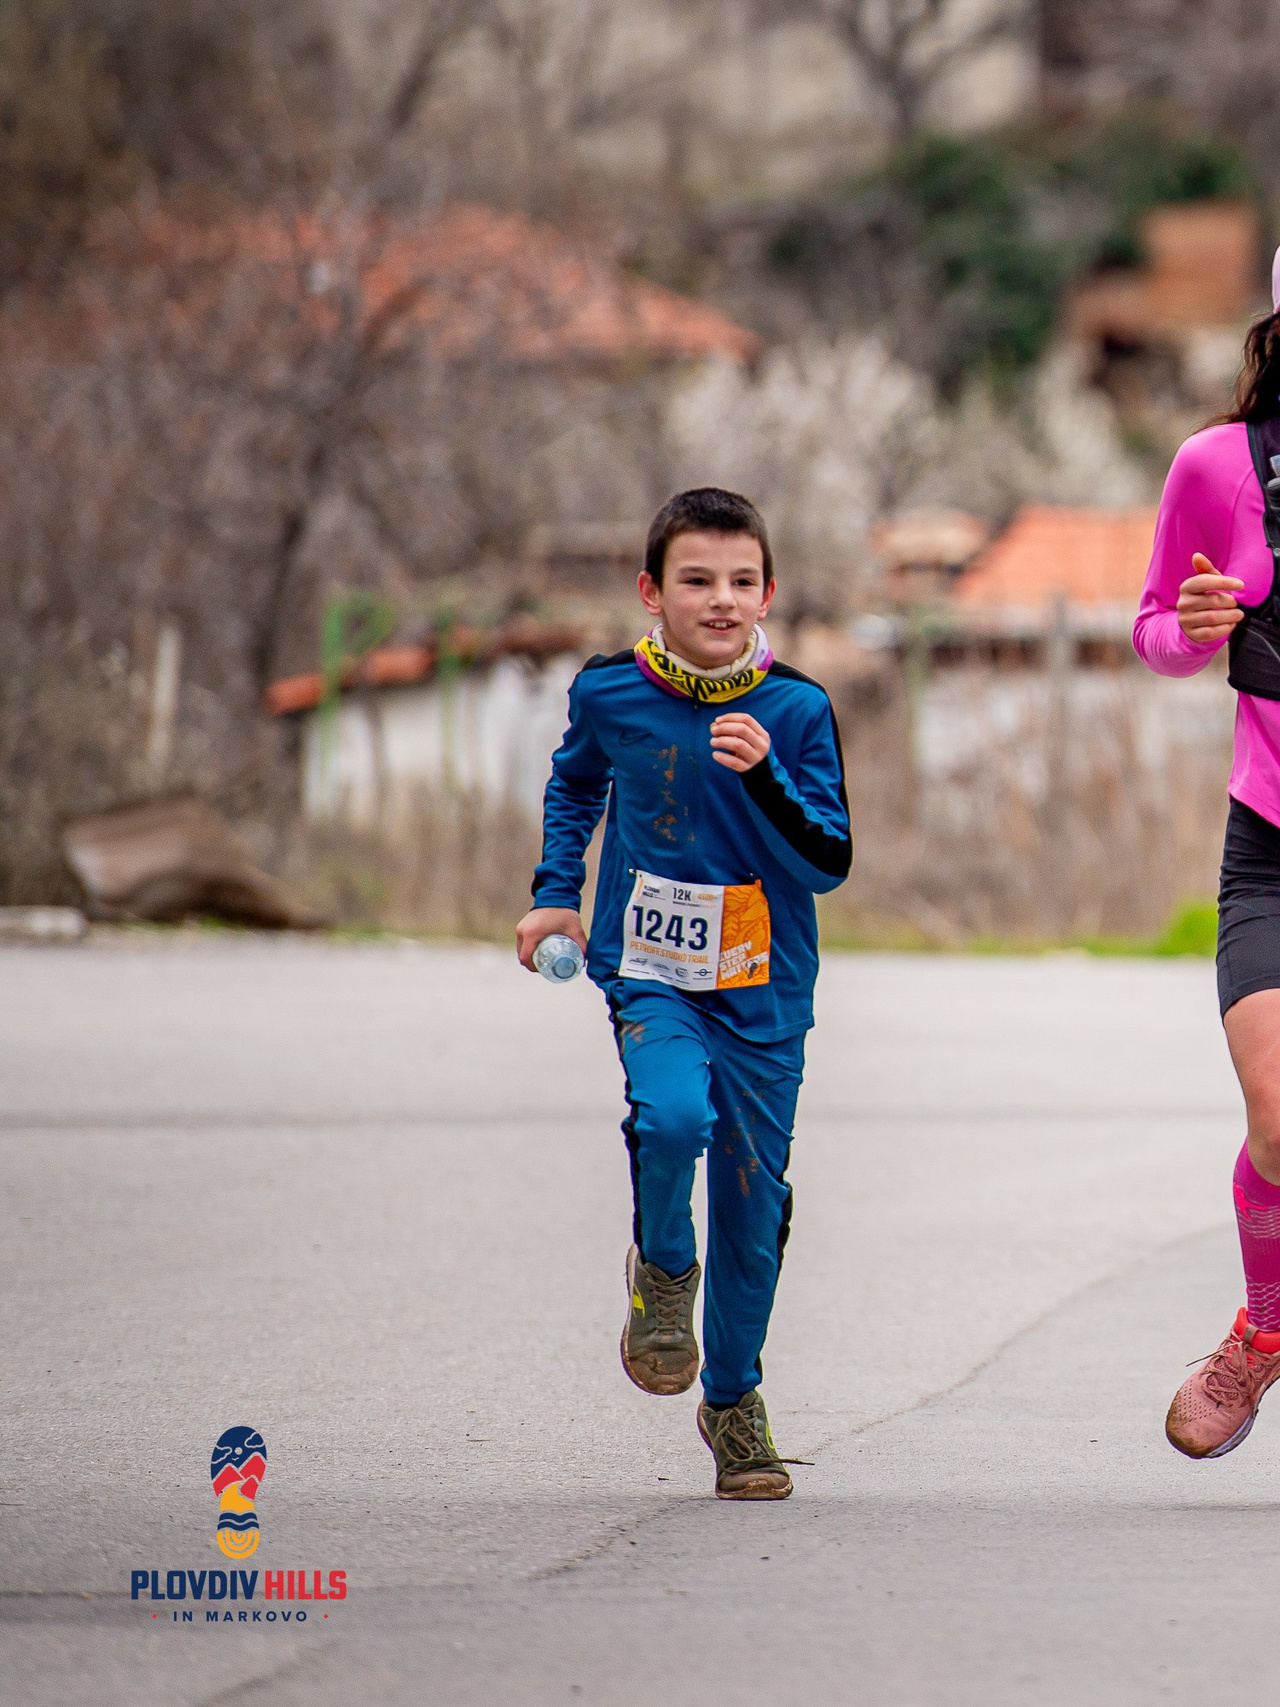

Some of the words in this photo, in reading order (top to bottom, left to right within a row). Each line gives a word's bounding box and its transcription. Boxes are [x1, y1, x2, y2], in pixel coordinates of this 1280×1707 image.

[672, 887, 692, 902] 12K
[632, 904, 709, 951] 1243
[719, 953, 746, 972] STEP
